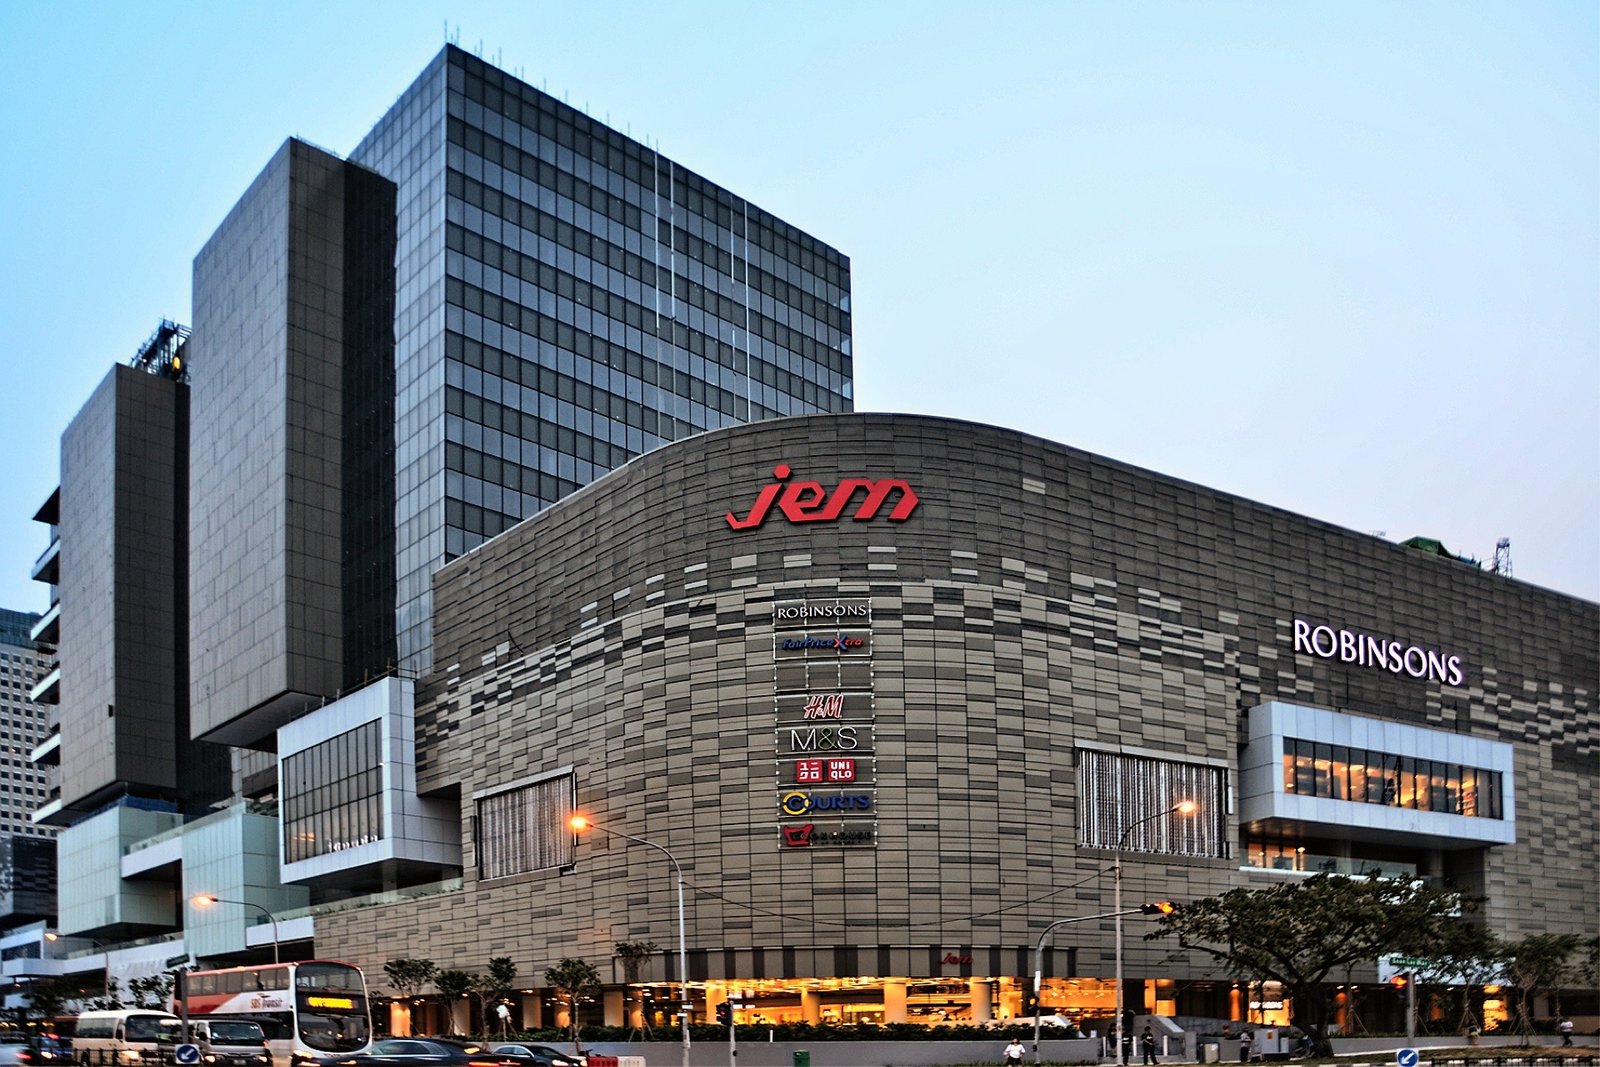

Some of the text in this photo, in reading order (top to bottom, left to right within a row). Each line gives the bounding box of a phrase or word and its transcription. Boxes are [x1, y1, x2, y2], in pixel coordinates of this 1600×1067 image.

[725, 463, 919, 530] jem
[777, 605, 867, 618] ROBINSONS
[1294, 619, 1463, 686] ROBINSONS
[803, 694, 844, 718] H&M
[791, 726, 858, 750] M&S
[830, 761, 850, 770] UNI
[830, 770, 852, 779] QLO
[784, 792, 871, 812] COURTS
